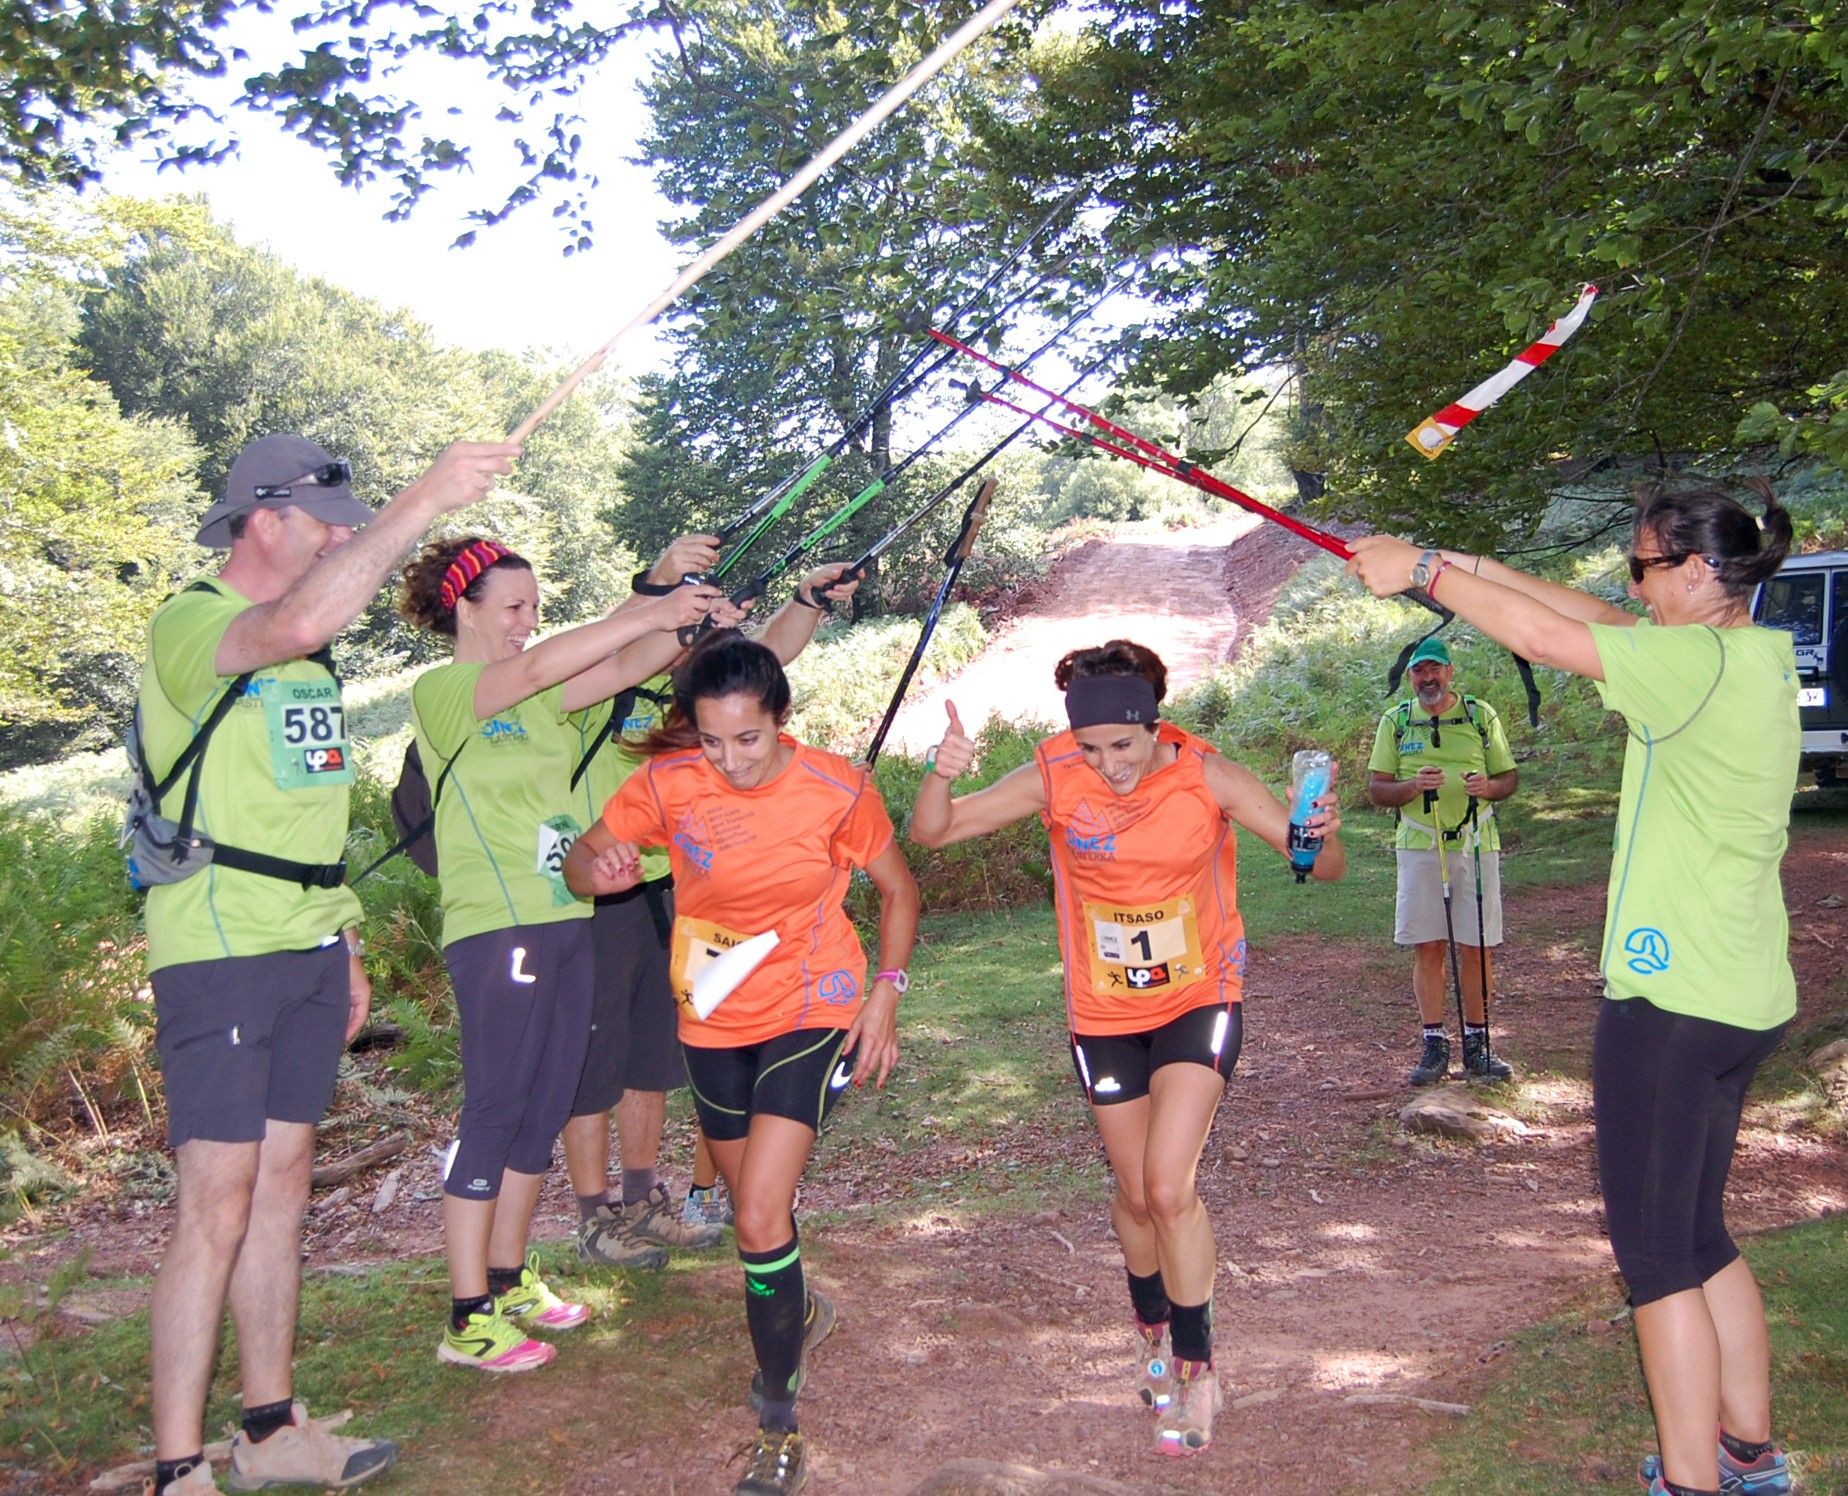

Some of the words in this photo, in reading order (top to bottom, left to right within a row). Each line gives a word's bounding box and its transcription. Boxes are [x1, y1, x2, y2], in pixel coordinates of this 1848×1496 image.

[292, 687, 333, 699] OSCAR
[285, 705, 346, 744] 587
[1113, 910, 1165, 923] ITSASO
[713, 932, 744, 947] SAI
[1131, 930, 1153, 961] 1
